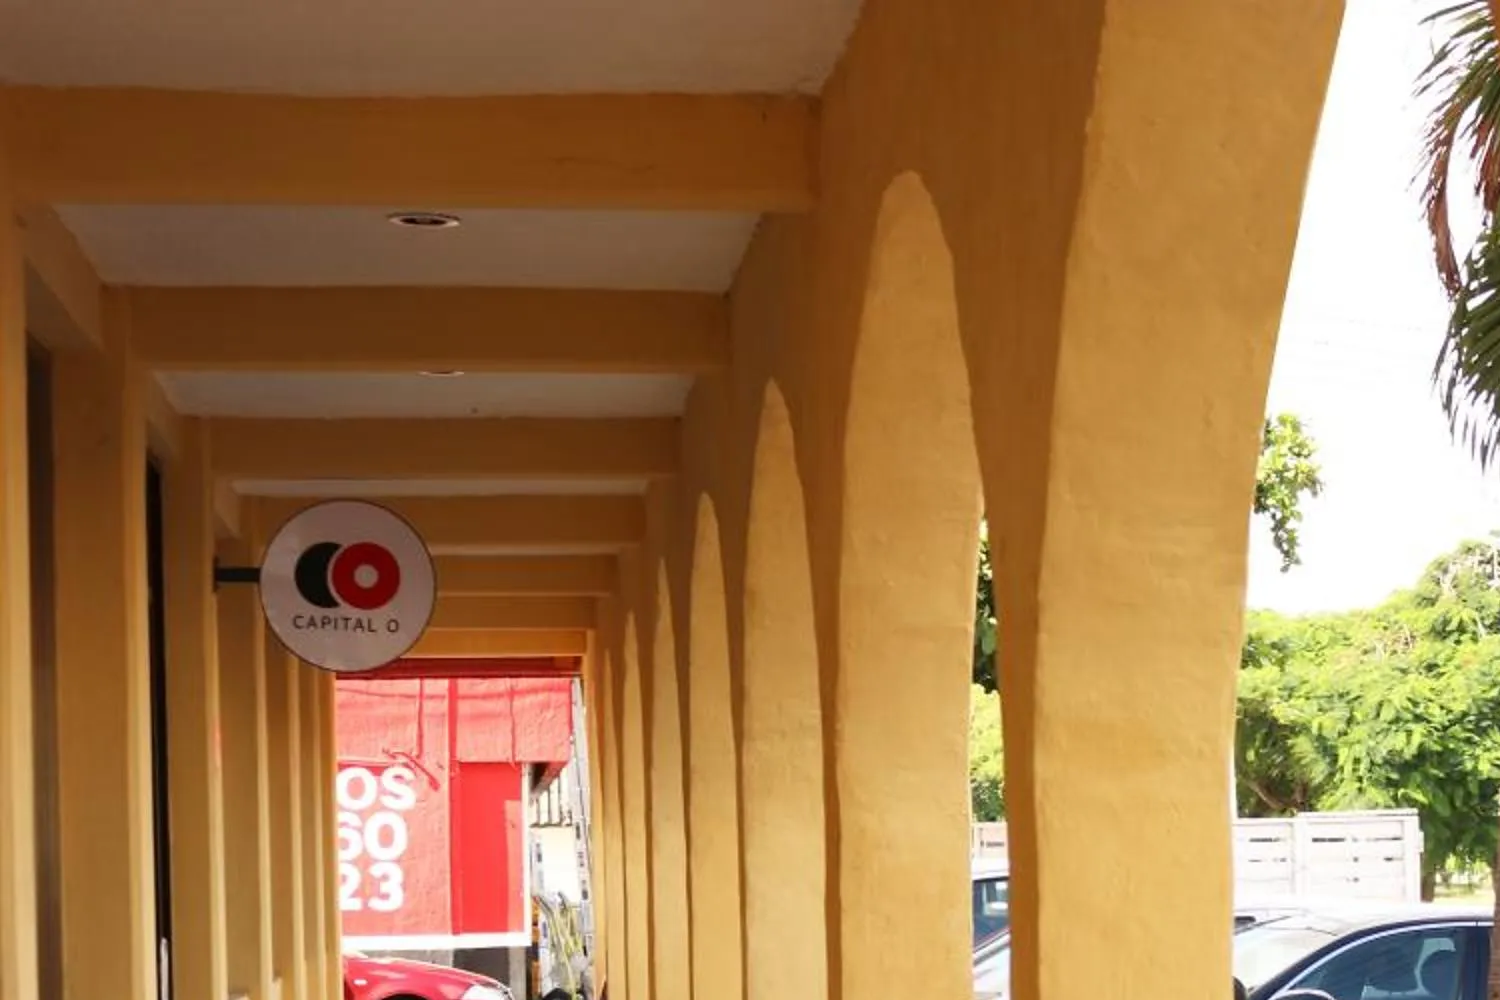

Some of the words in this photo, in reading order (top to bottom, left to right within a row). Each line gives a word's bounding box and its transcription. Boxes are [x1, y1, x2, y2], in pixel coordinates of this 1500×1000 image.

[292, 614, 377, 633] CAPITAL
[387, 618, 400, 633] O
[339, 861, 404, 912] 23
